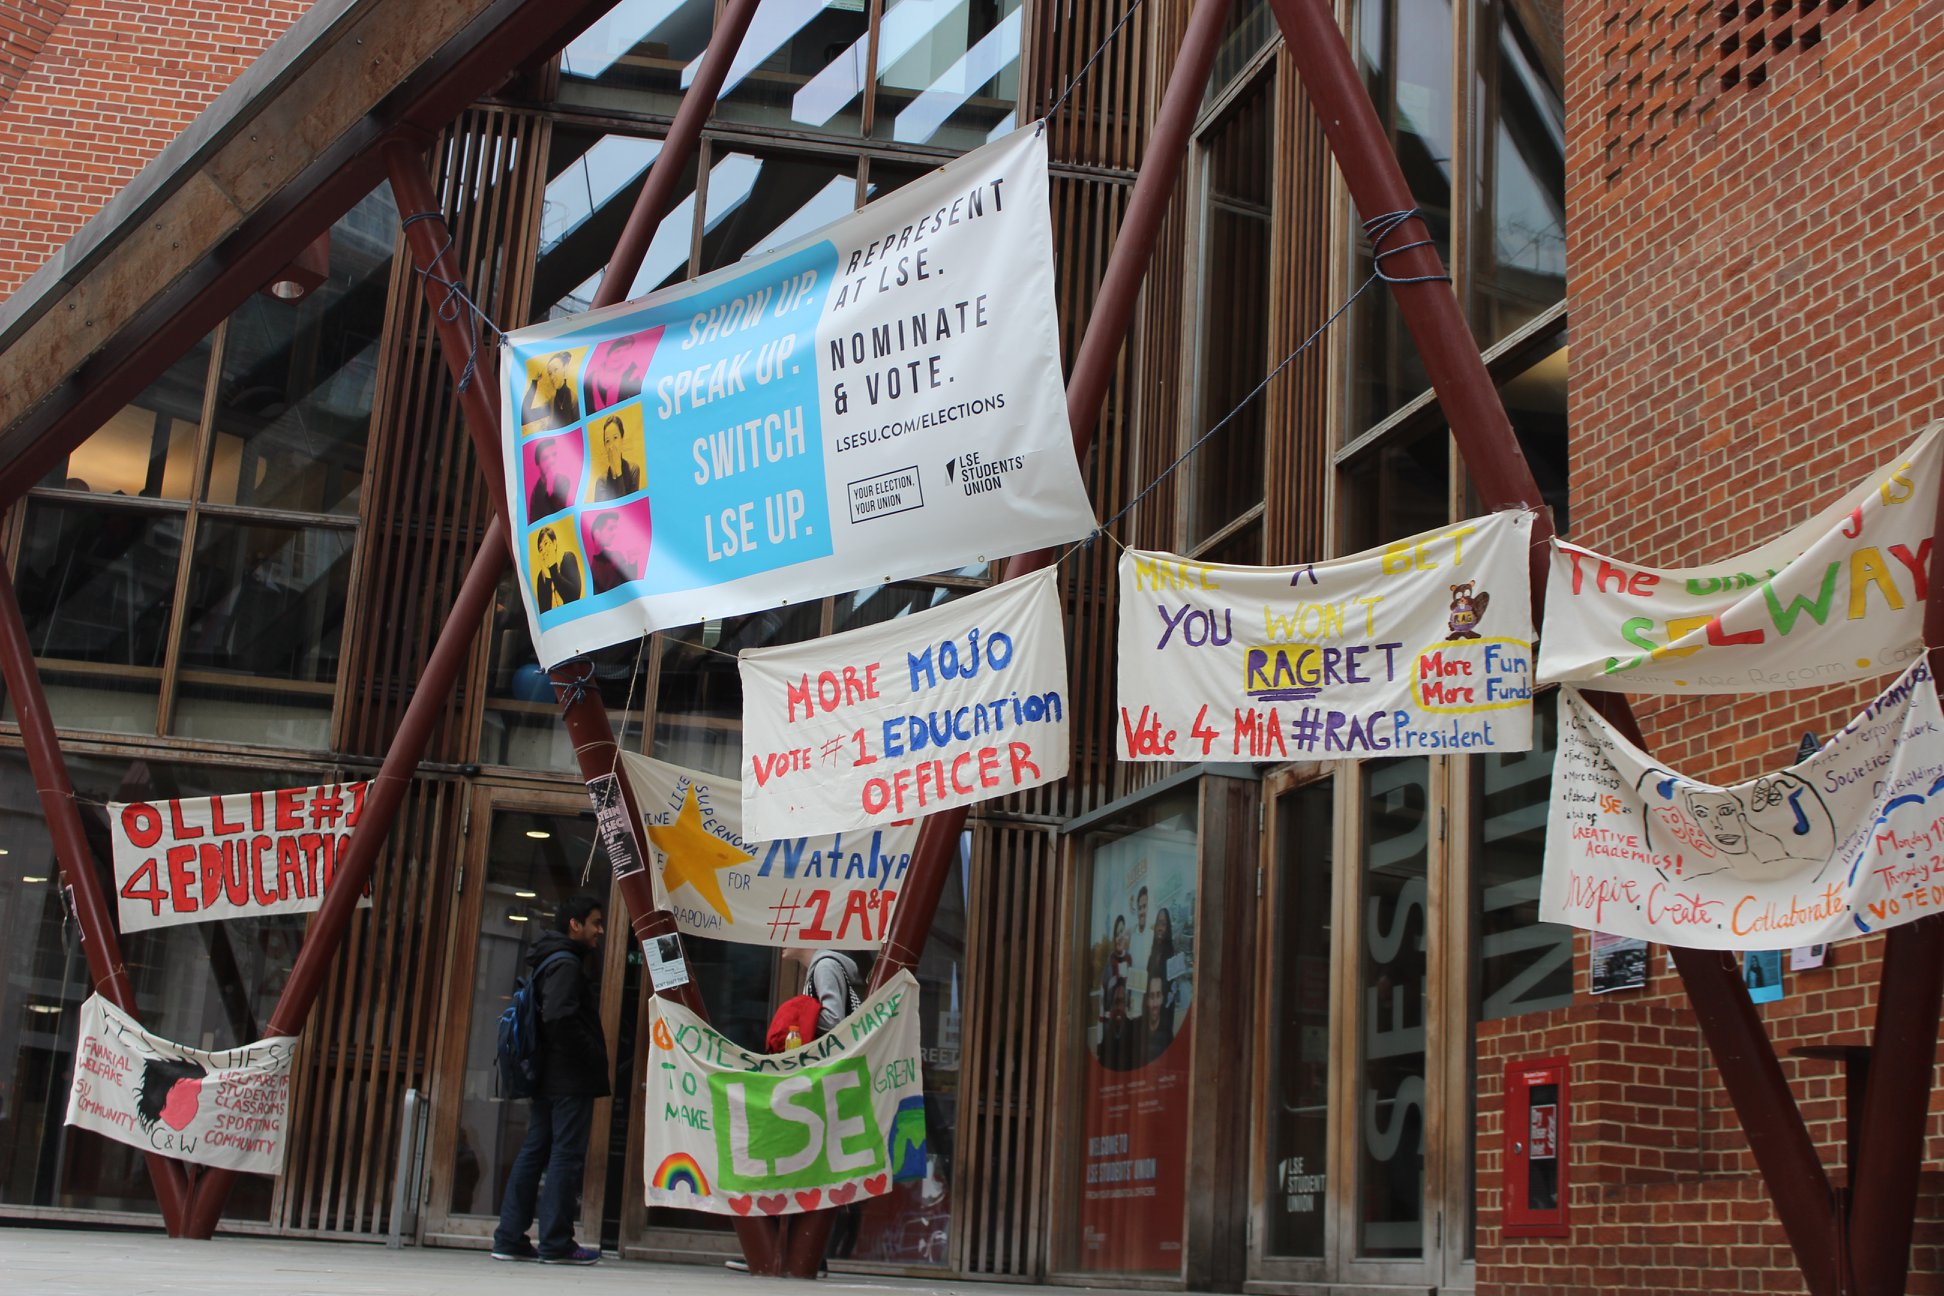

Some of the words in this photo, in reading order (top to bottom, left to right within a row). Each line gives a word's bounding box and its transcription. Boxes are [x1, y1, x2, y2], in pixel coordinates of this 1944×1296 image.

[846, 178, 1003, 276] REPRESENT
[833, 277, 867, 311] AT
[879, 248, 944, 293] LSE.
[681, 287, 771, 350] SHOW
[774, 270, 818, 317] UP.
[830, 294, 987, 372] NOMINATE
[657, 349, 751, 420] SPEAK
[755, 333, 799, 386] UP.
[834, 382, 848, 416] &
[866, 355, 954, 406] VOTE.
[693, 405, 806, 486] SWITCH
[836, 394, 1005, 453] LSESU.COM/ELECTIONS
[959, 452, 980, 469] LSE
[854, 486, 875, 501] YOUR
[855, 501, 878, 516] YOUR
[879, 493, 902, 511] UNION
[964, 477, 1002, 497] UNION
[705, 501, 757, 562] LSE
[765, 489, 813, 545] UP.
[1381, 527, 1475, 575] BET
[1559, 547, 1660, 597] The
[1157, 604, 1232, 650] YOU
[1264, 596, 1384, 640] WON'T
[1248, 643, 1403, 689] RAGRET
[1420, 652, 1472, 680] More
[1485, 644, 1527, 674] Fun
[787, 662, 880, 723] MORE
[1422, 682, 1474, 706] More
[1487, 677, 1532, 701] Funds
[1121, 705, 1176, 758] Vote
[1191, 704, 1220, 756] 4
[753, 748, 811, 788] VOTE
[862, 742, 1040, 815] OFFICER
[1824, 752, 1892, 793] Societies
[1893, 721, 1939, 747] Nwork
[668, 774, 691, 811] LIKE
[694, 785, 759, 857] SUPERNOVA
[1600, 795, 1622, 815] LSE
[1573, 822, 1638, 848] CREATIVE
[1876, 829, 1934, 856] Monday
[120, 832, 371, 916] 4EDUCATI
[728, 872, 750, 890] FOR
[1868, 885, 1929, 920] VOTE
[1932, 884, 1944, 905] O
[666, 1016, 734, 1067] VOTE
[740, 1034, 845, 1072] SASKIA
[850, 993, 901, 1041] MARIE
[75, 1078, 91, 1096] SU
[662, 1062, 696, 1096] TO
[77, 1094, 138, 1132] COMMUNITY
[666, 1103, 711, 1131] MAKE
[726, 1071, 878, 1178] LSE
[204, 1130, 276, 1154] COMMUNITY
[1288, 1157, 1304, 1174] LSE
[1288, 1195, 1314, 1212] UNION
